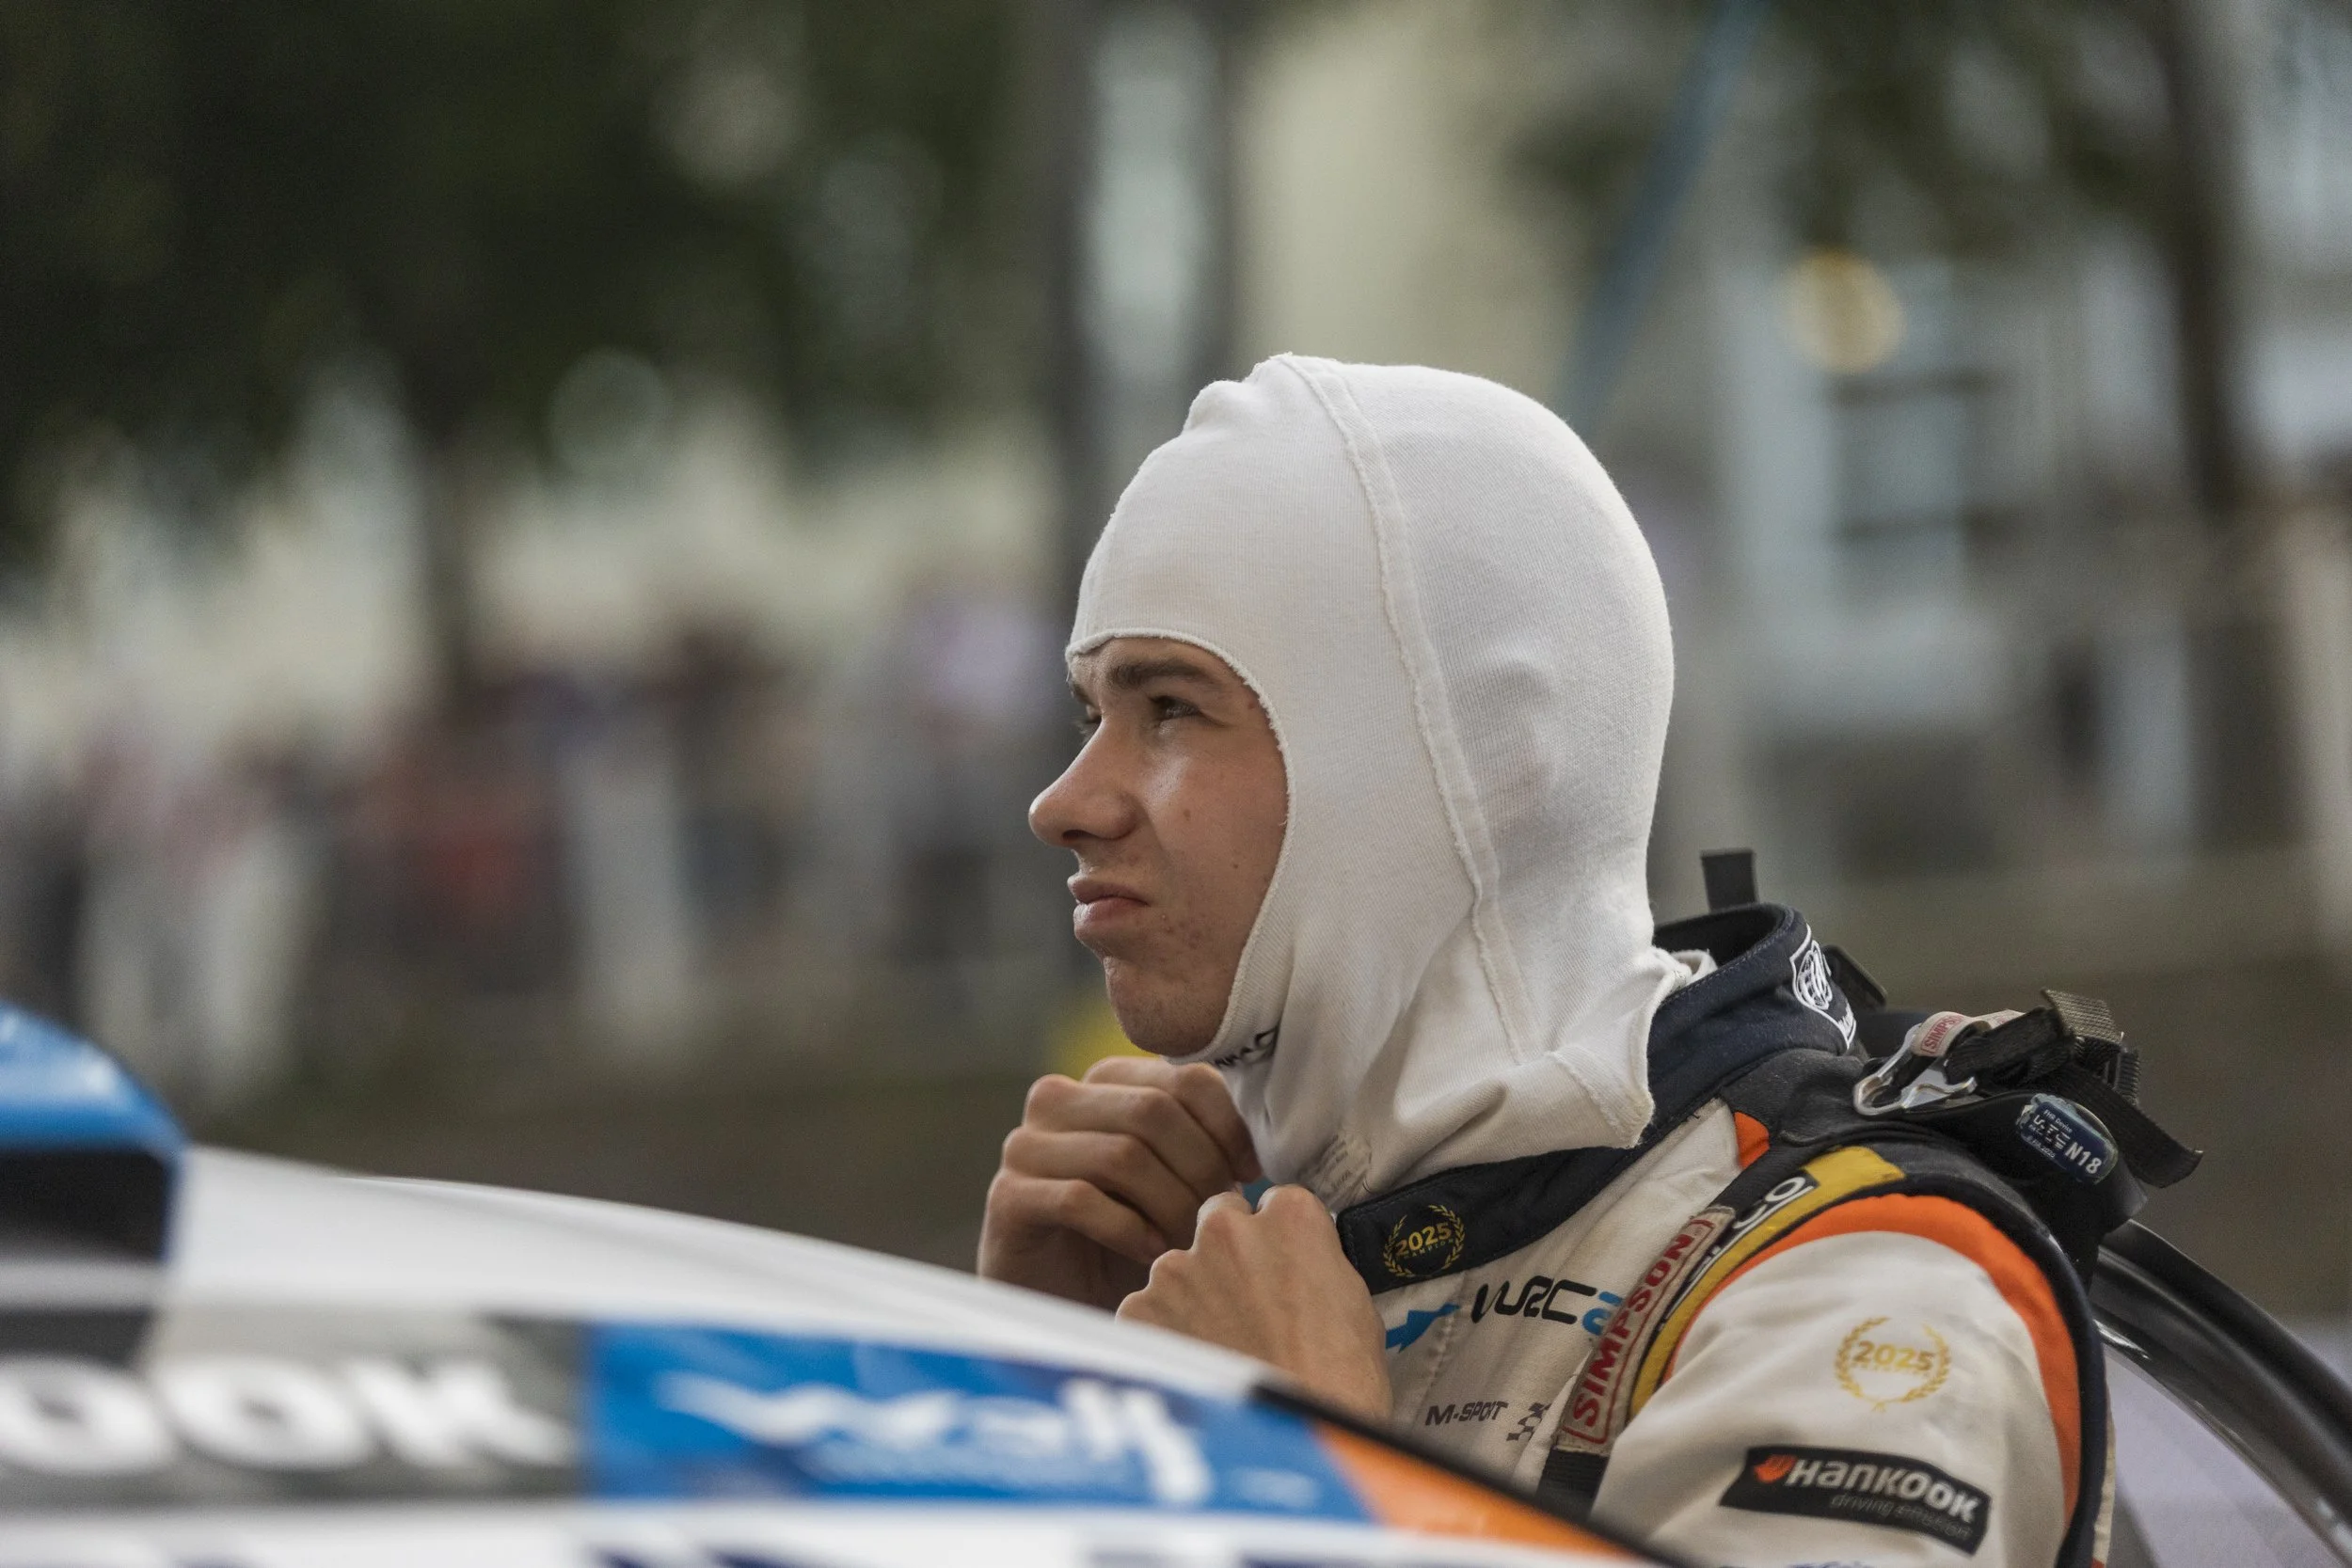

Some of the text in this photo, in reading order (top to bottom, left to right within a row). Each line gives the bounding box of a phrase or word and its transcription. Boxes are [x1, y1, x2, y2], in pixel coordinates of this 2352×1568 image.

[1925, 1015, 1964, 1050] SIMPS
[2064, 1140, 2104, 1176] N18
[1394, 1223, 1453, 1258] 2025
[1572, 1233, 1694, 1427] SIMPSON
[1852, 1340, 1935, 1371] 2025
